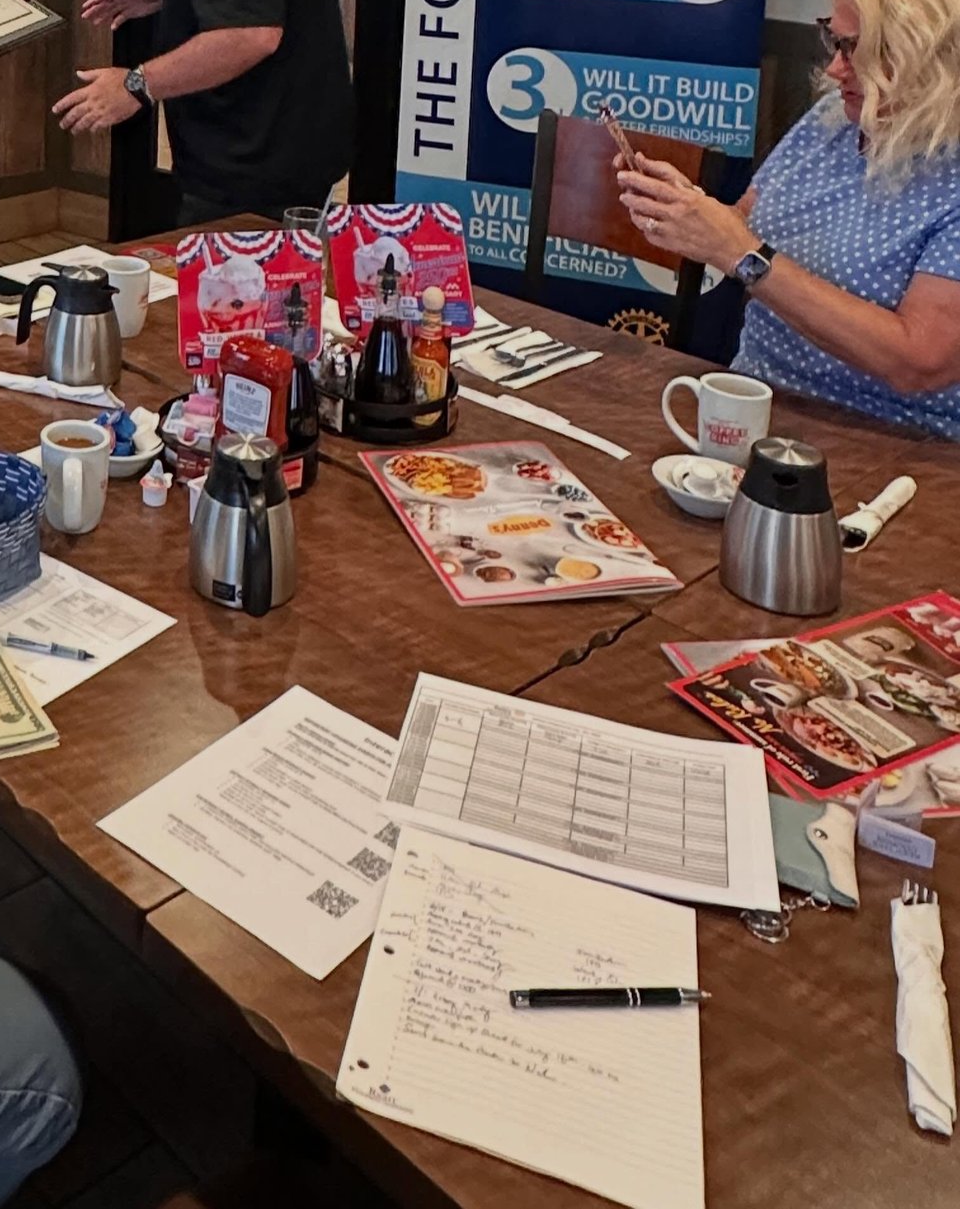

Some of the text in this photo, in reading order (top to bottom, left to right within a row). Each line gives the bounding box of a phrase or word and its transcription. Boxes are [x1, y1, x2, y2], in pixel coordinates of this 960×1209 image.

[582, 67, 755, 104] WILL IT BUILD
[413, 60, 458, 157] THE
[581, 91, 752, 130] GOODWILL
[649, 123, 750, 146] FRIENDSHIPS?
[471, 189, 532, 222] WIL
[469, 244, 627, 280] TO ALL COCERNED?
[491, 518, 552, 535] Denny's
